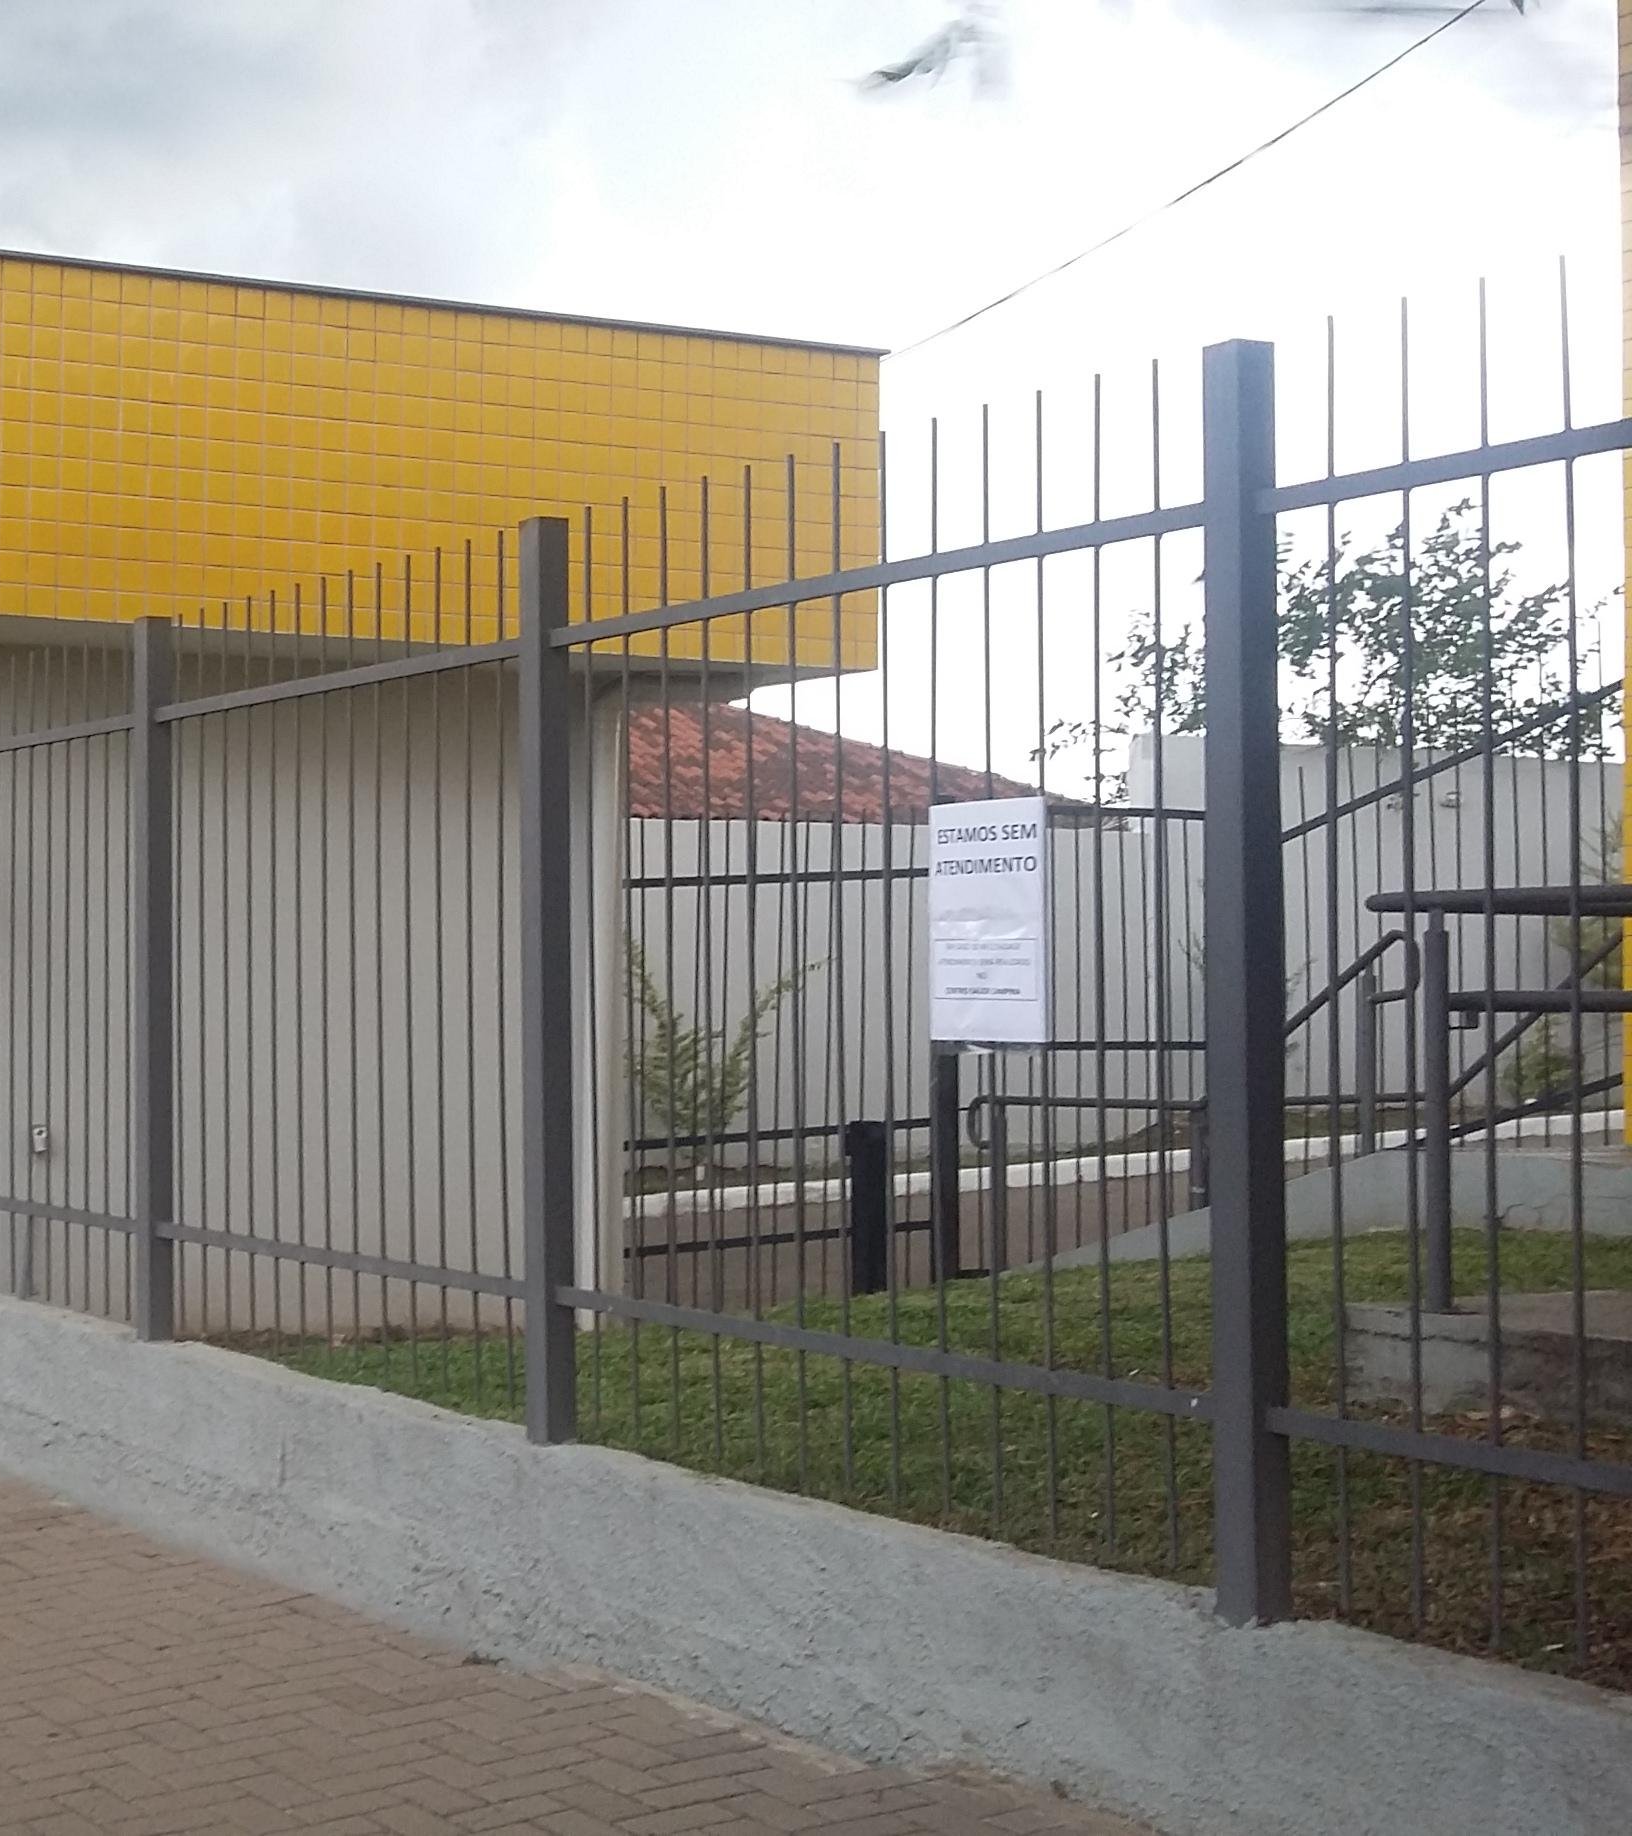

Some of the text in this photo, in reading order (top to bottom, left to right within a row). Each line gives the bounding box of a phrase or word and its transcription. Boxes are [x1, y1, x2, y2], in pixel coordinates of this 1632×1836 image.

[937, 823, 1037, 845] ESTAMOS SEM
[935, 856, 1037, 876] ATENDIMENTO
